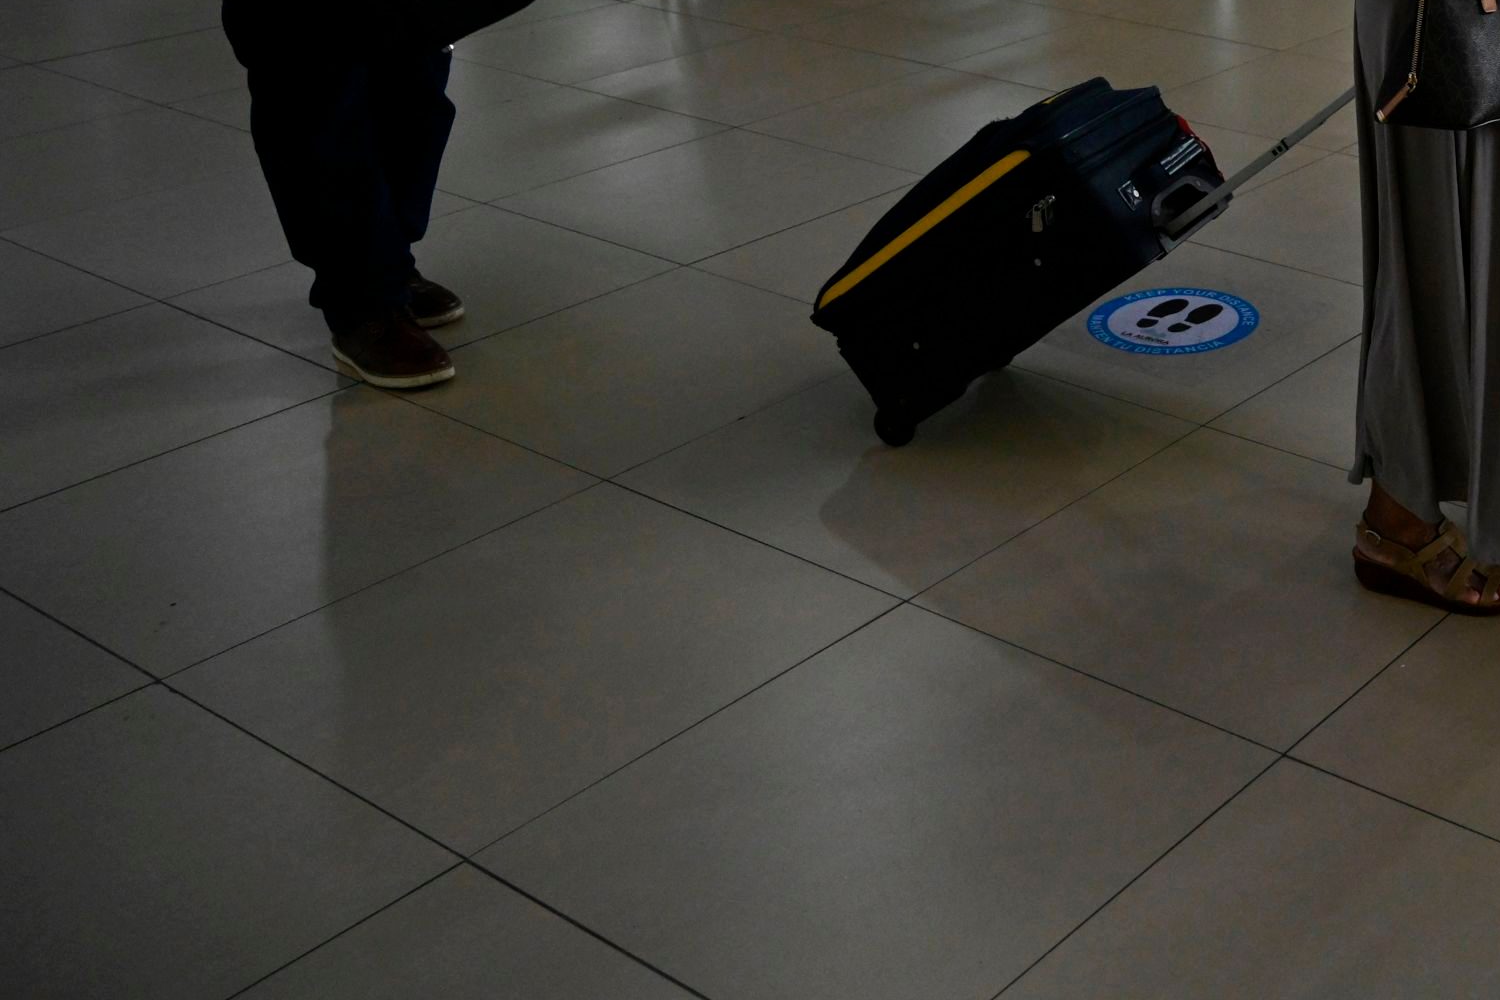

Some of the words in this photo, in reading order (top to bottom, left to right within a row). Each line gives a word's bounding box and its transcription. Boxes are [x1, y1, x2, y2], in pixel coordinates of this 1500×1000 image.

[1124, 289, 1166, 301] KEEP
[1173, 289, 1217, 298] YOUR
[1219, 293, 1255, 326] DISTANCE
[1113, 339, 1132, 350] TU
[1134, 340, 1224, 355] DISTANCIA
[1134, 334, 1170, 345] AURORA
